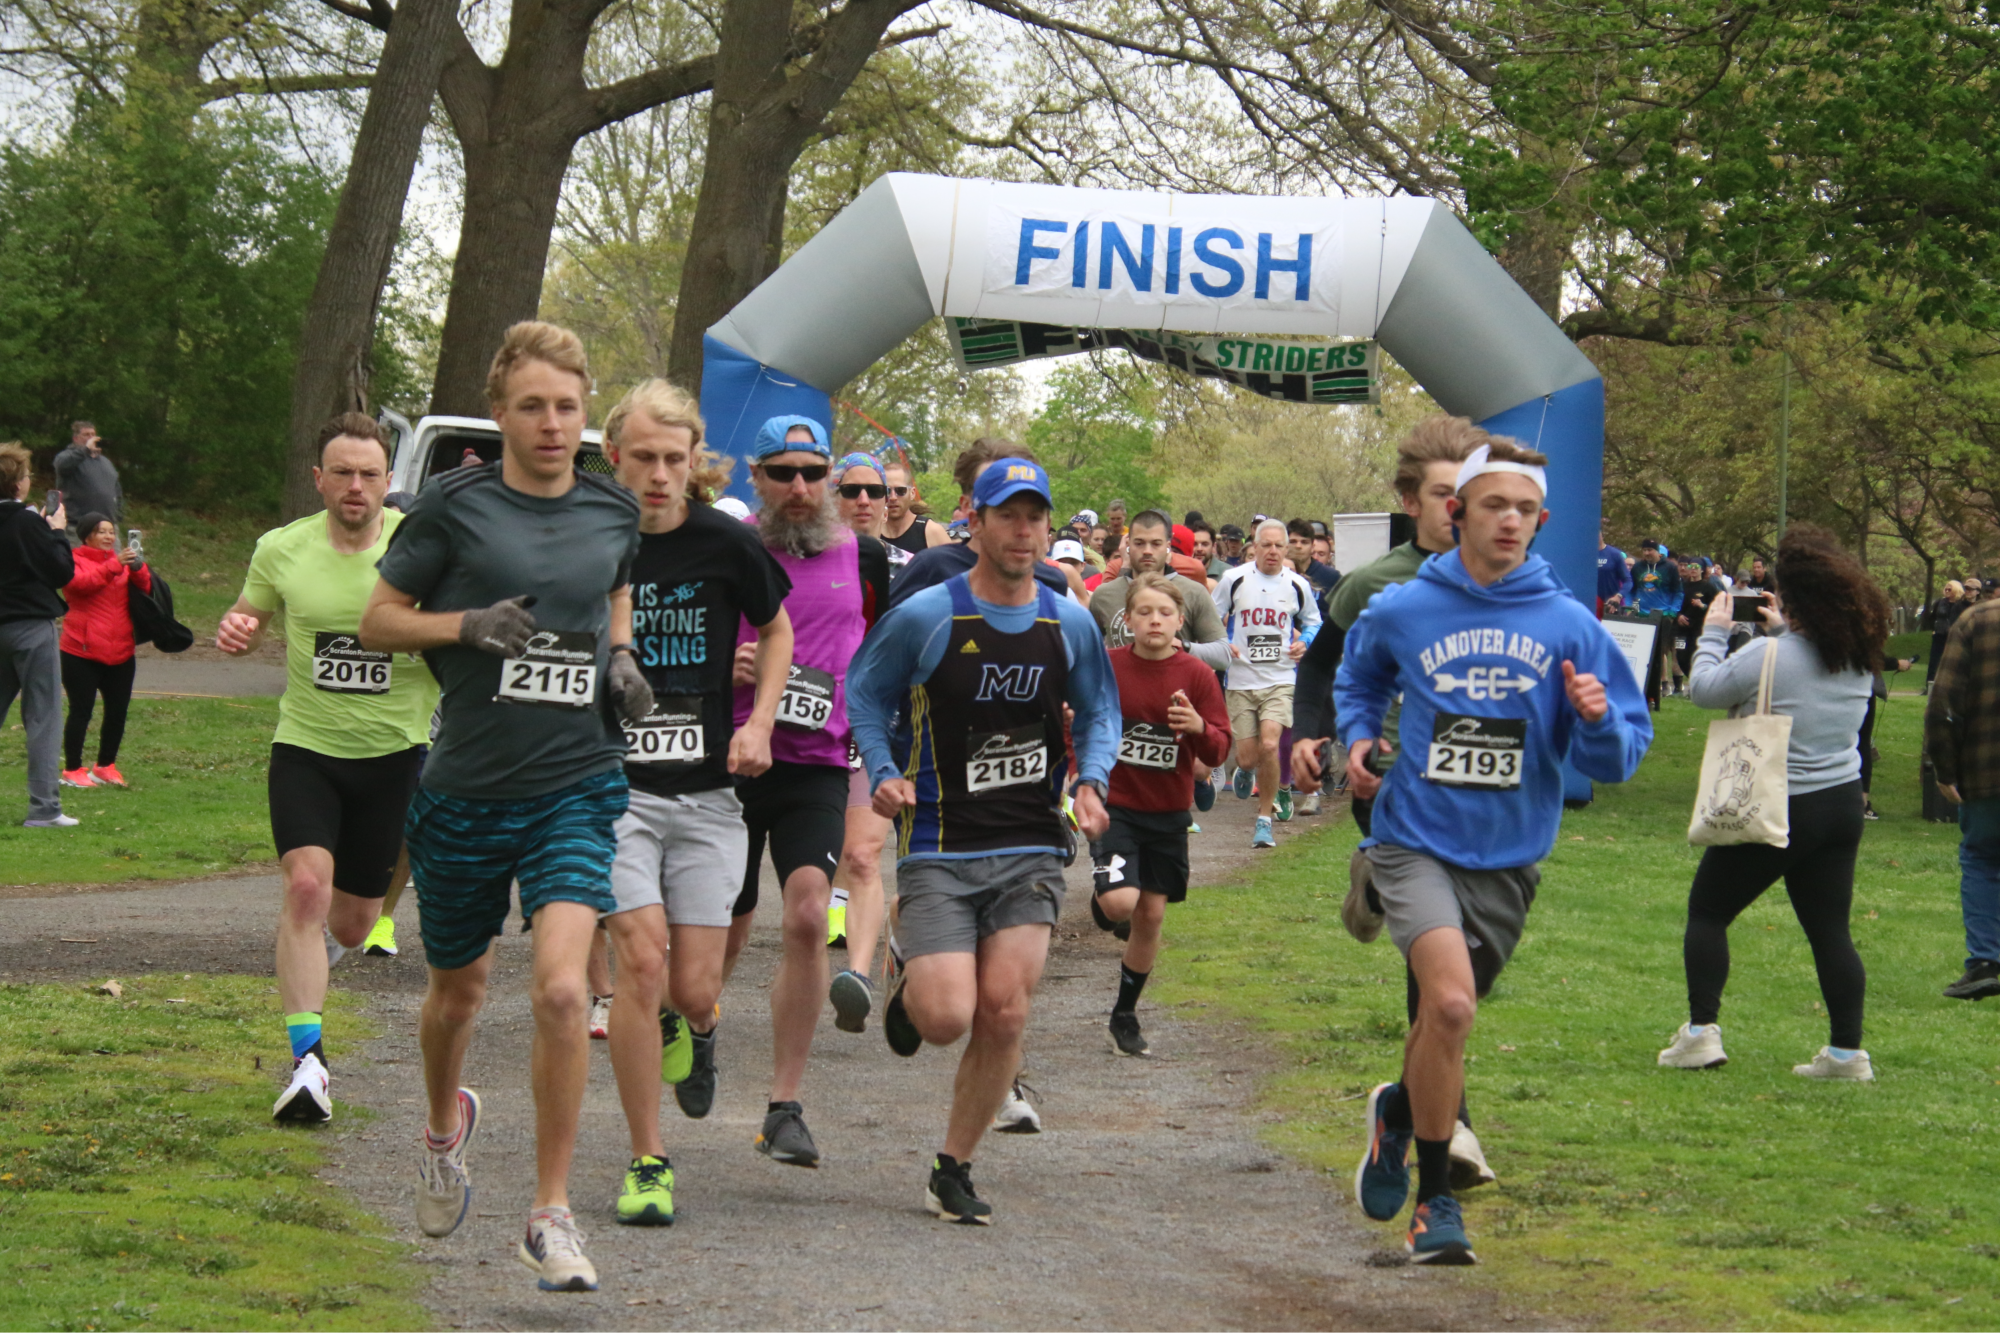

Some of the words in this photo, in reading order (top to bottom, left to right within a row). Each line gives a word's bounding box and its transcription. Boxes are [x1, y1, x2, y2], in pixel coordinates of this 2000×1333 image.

[1014, 217, 1313, 301] FINISH
[1216, 340, 1368, 373] STRIDERS
[1006, 464, 1037, 481] MU
[638, 583, 658, 607] IS
[632, 607, 707, 634] RYONE
[1240, 607, 1288, 629] TCRC
[632, 635, 706, 667] SING
[1250, 647, 1281, 658] 2129
[1419, 628, 1505, 676] HANOVER
[1506, 632, 1553, 679] AREA
[317, 660, 387, 684] 2016
[509, 663, 589, 695] 2115
[974, 664, 1045, 701] MU
[1467, 667, 1508, 700] CC
[662, 713, 691, 721] Running
[781, 693, 828, 722] 158
[624, 728, 698, 755] 2070
[1121, 741, 1175, 763] 2126
[973, 752, 1044, 784] 2182
[1436, 747, 1517, 777] 2193
